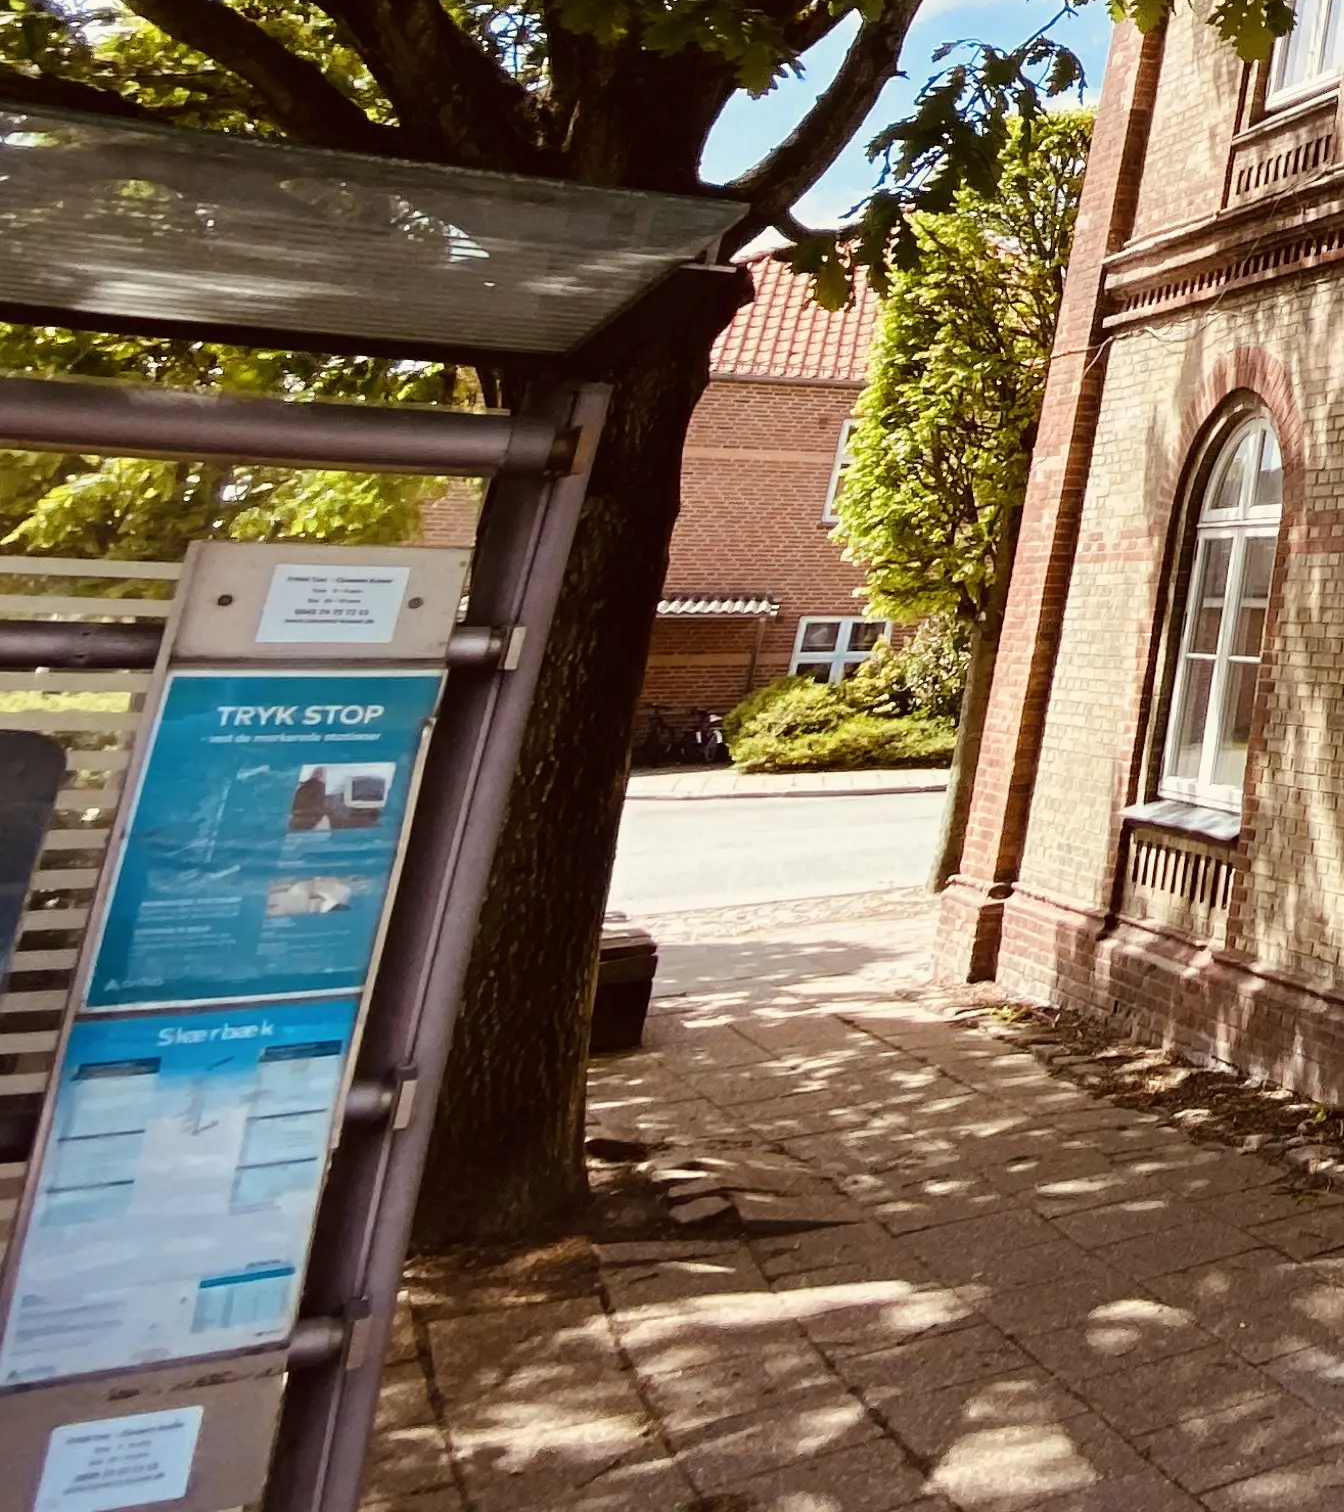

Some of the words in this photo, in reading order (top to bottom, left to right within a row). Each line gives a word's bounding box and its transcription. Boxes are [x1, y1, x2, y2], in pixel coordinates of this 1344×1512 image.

[217, 705, 299, 727] TRYK
[302, 704, 385, 726] STOP
[157, 1019, 275, 1047] Skærbæk
